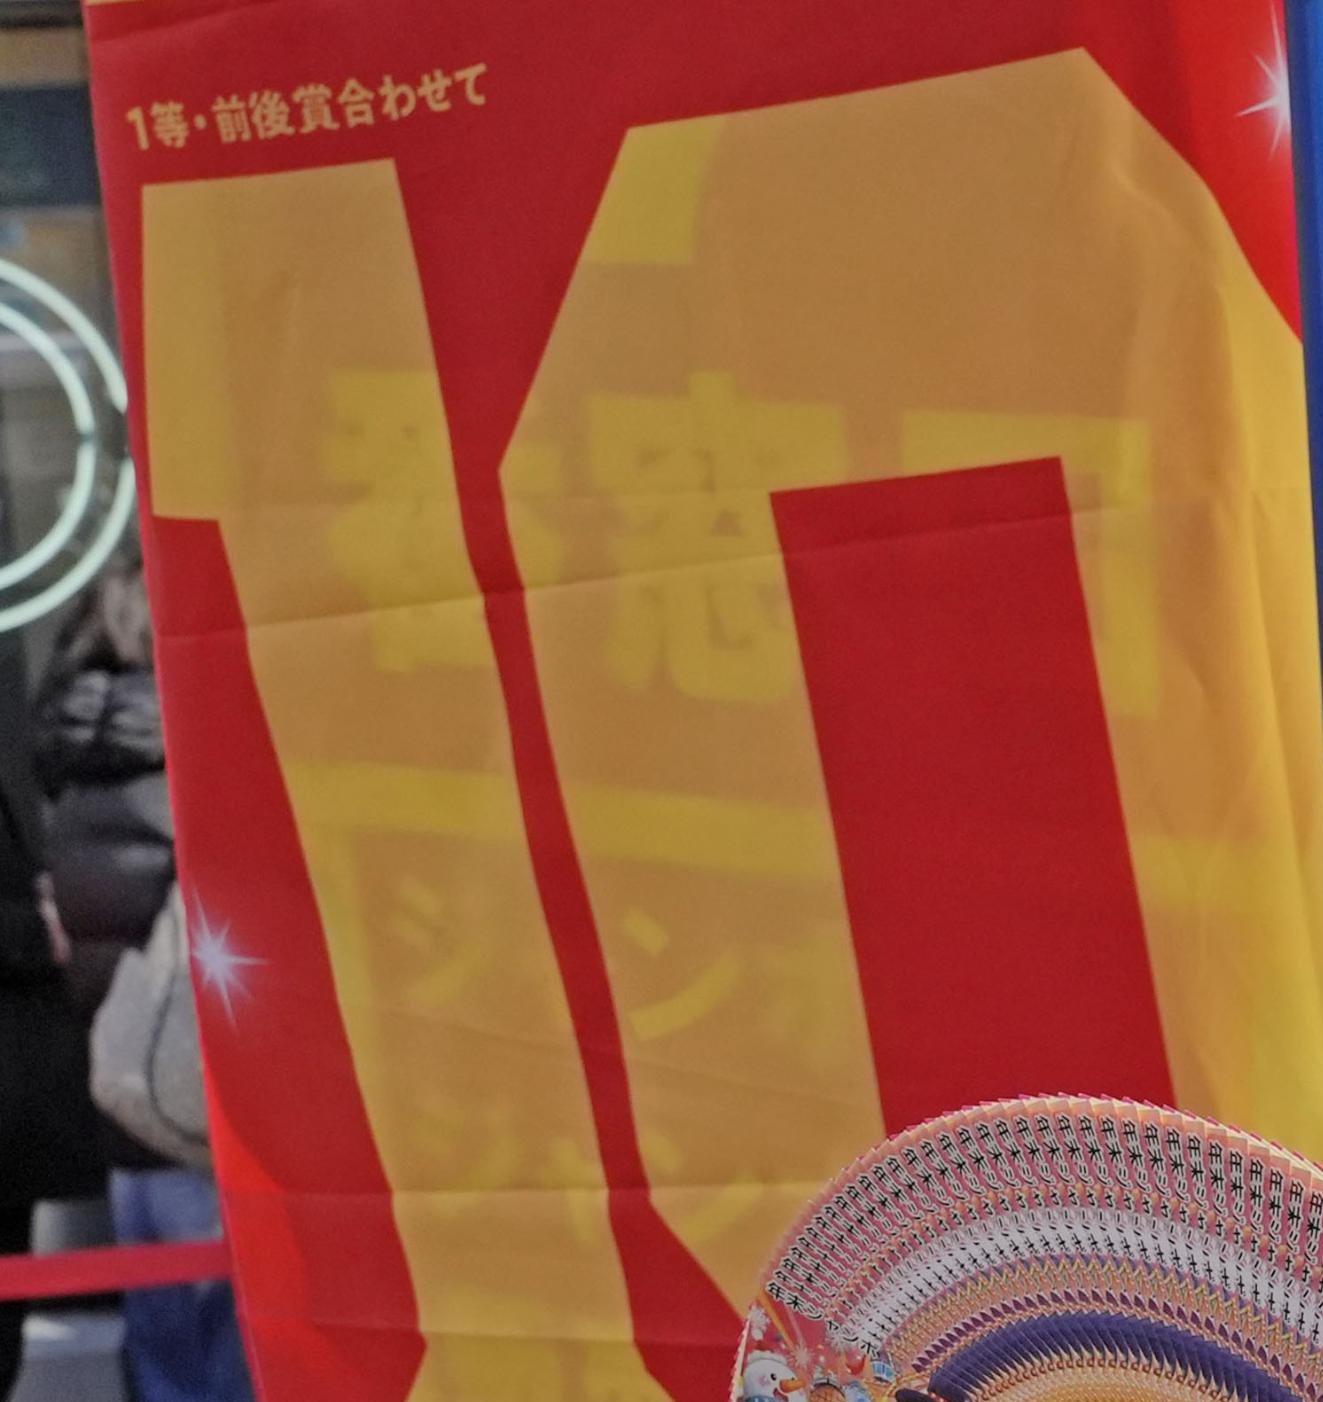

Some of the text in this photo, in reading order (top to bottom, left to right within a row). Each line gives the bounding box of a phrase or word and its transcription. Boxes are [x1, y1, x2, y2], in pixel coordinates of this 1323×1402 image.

[126, 63, 489, 151] 1等・前後賞合わせて
[766, 1281, 884, 1358] 年末ジャンボ
